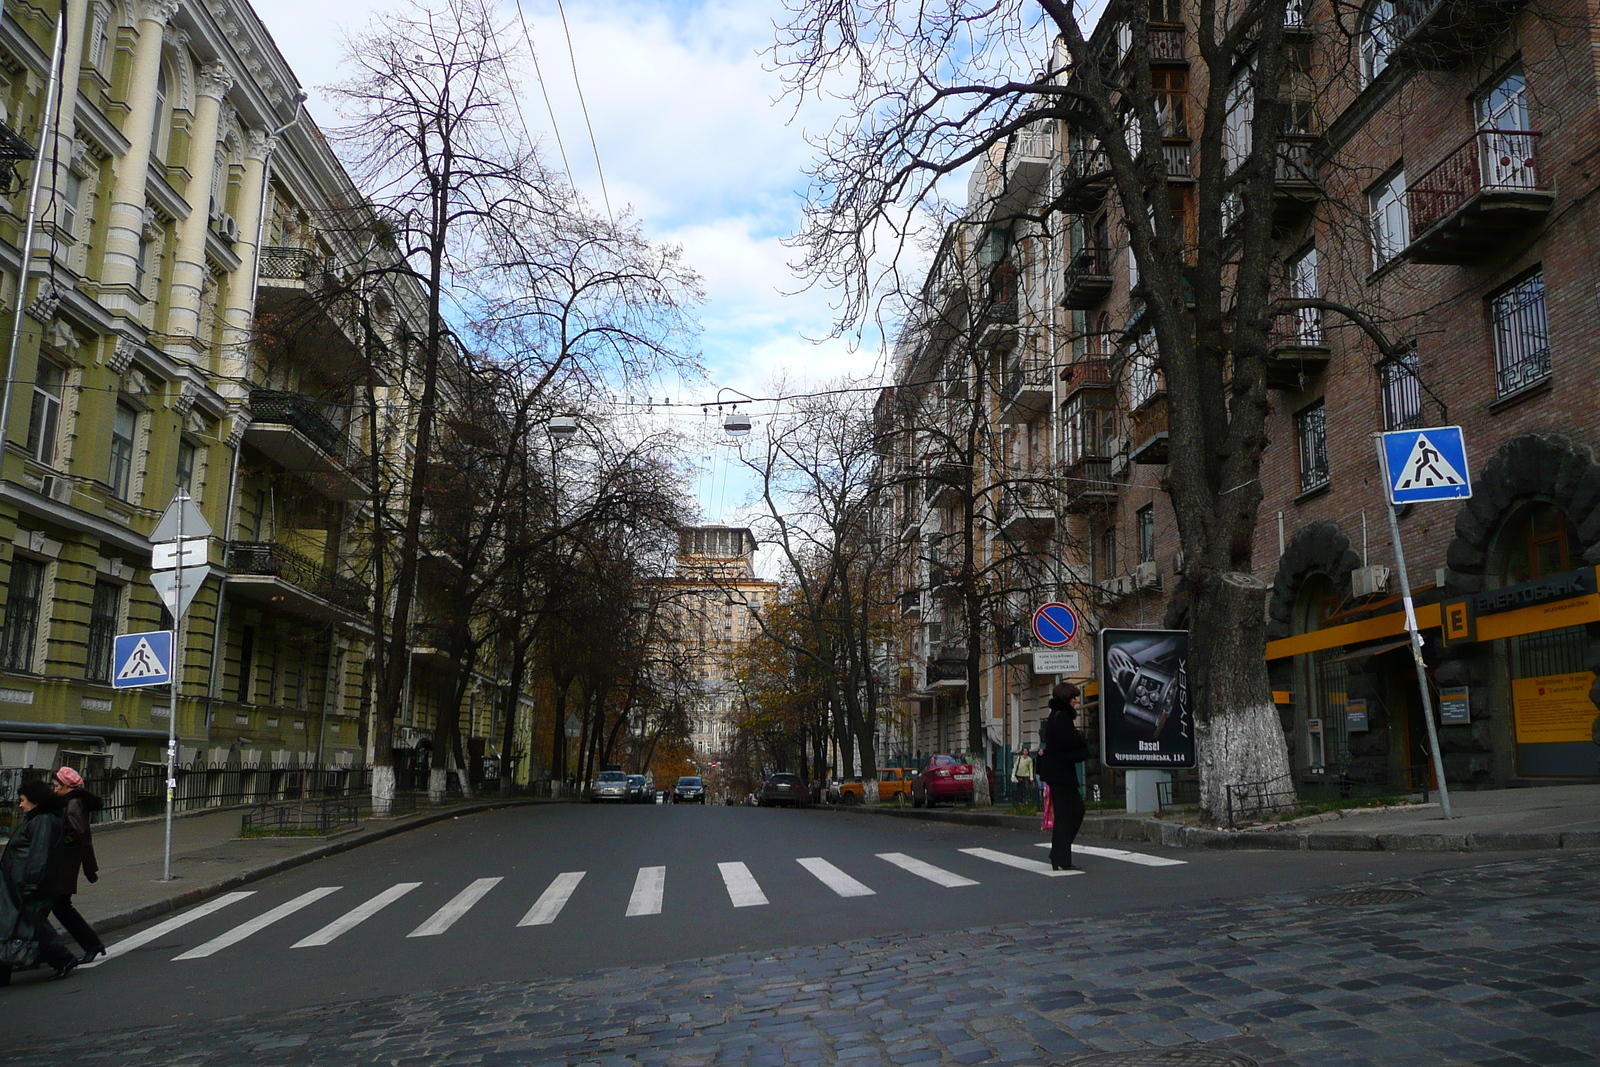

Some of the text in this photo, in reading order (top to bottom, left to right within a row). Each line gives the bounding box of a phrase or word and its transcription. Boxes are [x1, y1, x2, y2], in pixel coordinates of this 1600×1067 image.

[1178, 657, 1189, 739] HYSEK
[1138, 740, 1160, 751] Basel
[1173, 754, 1185, 762] 114
